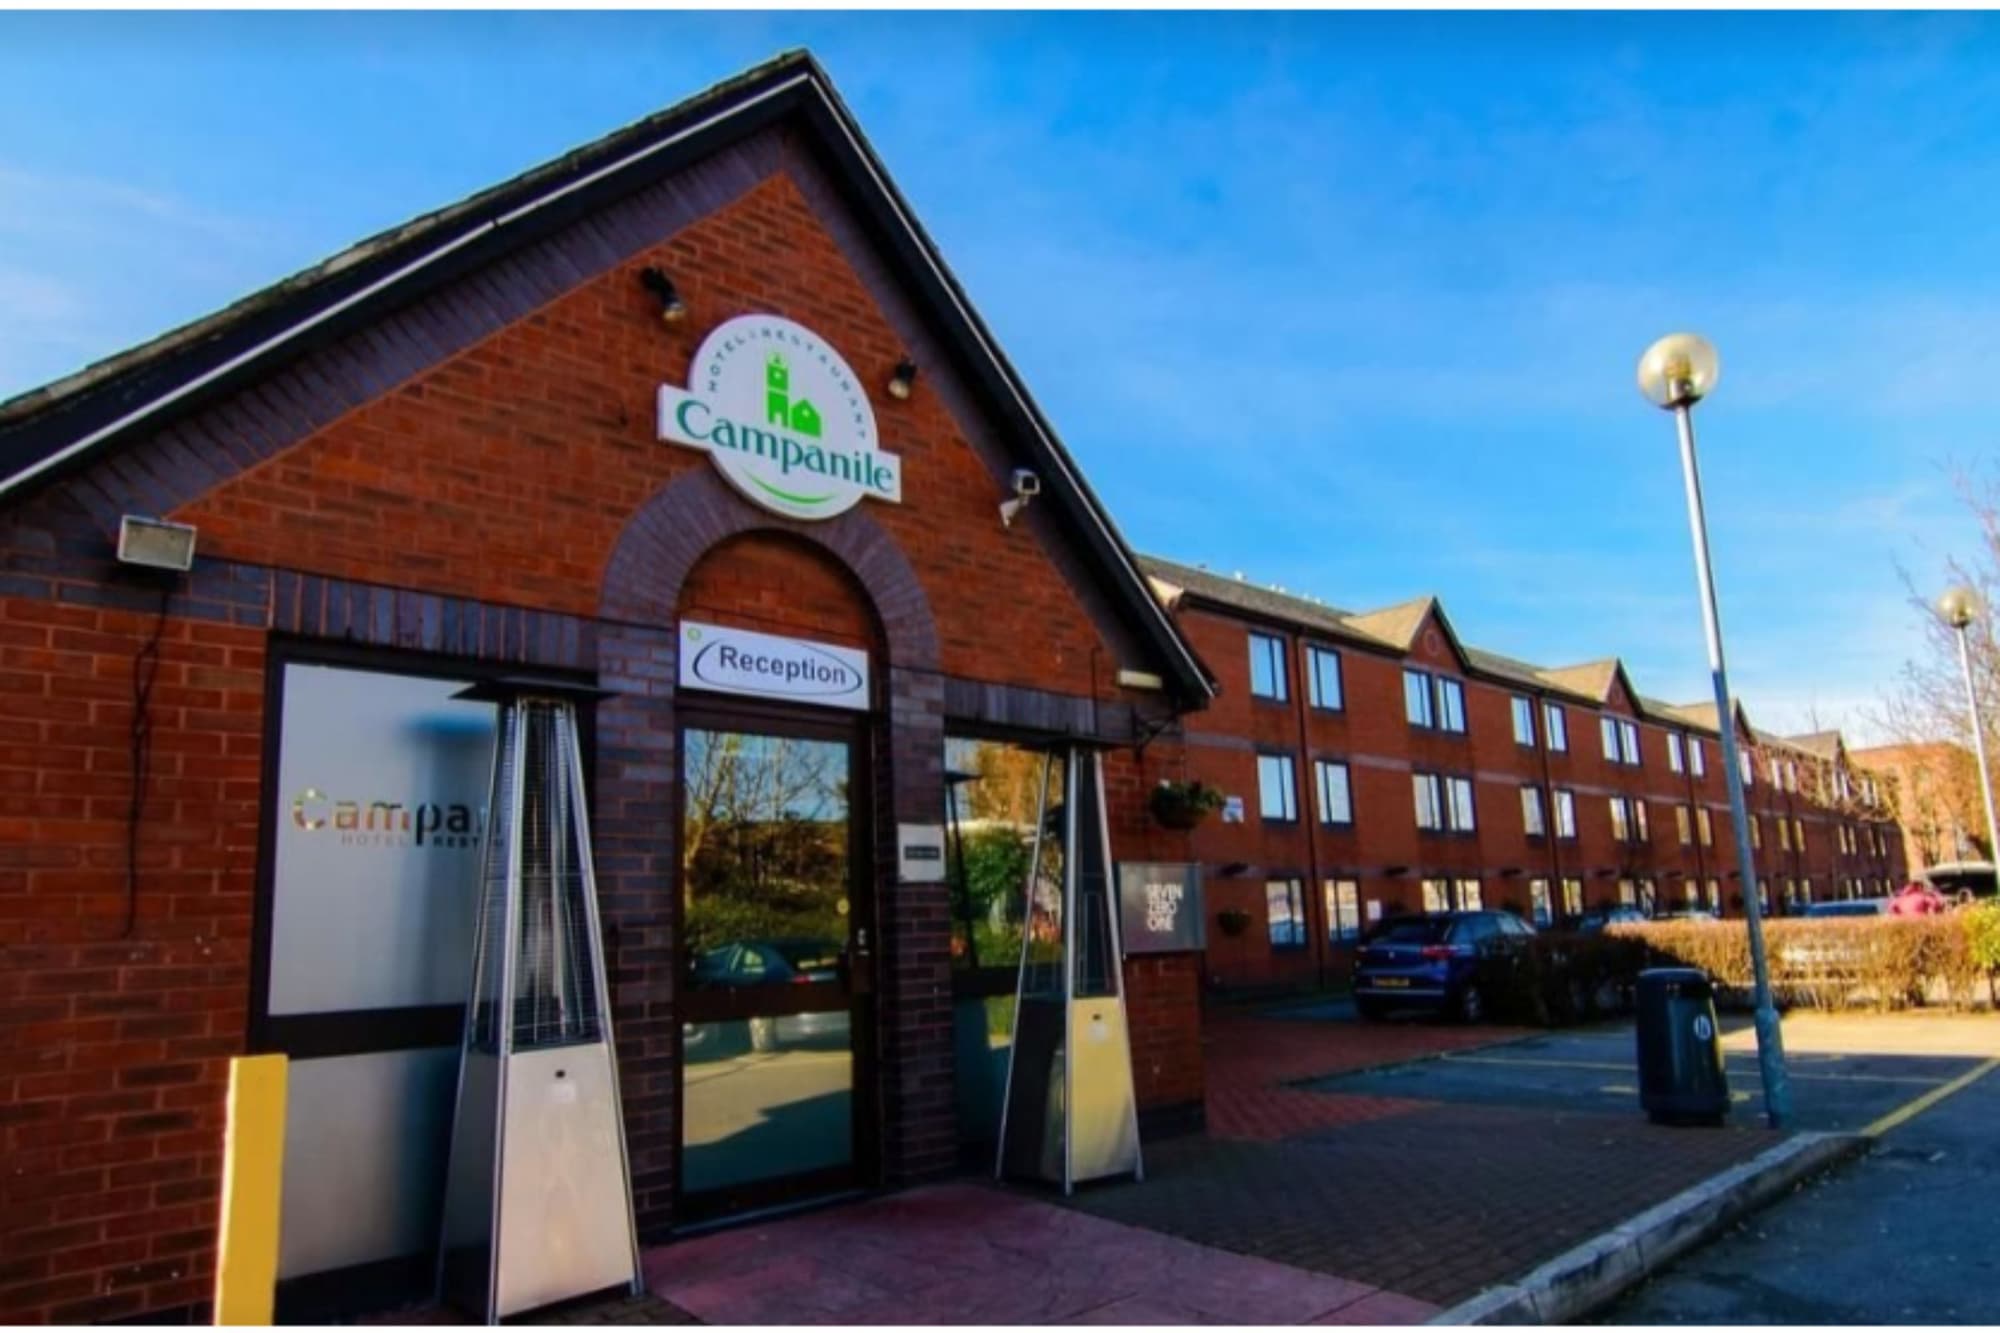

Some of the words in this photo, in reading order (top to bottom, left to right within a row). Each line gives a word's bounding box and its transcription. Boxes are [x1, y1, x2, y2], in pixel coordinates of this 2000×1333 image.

[708, 335, 746, 393] HOTEL
[676, 399, 895, 492] Campanile
[719, 645, 847, 685] Reception
[341, 833, 408, 846] HOTEL
